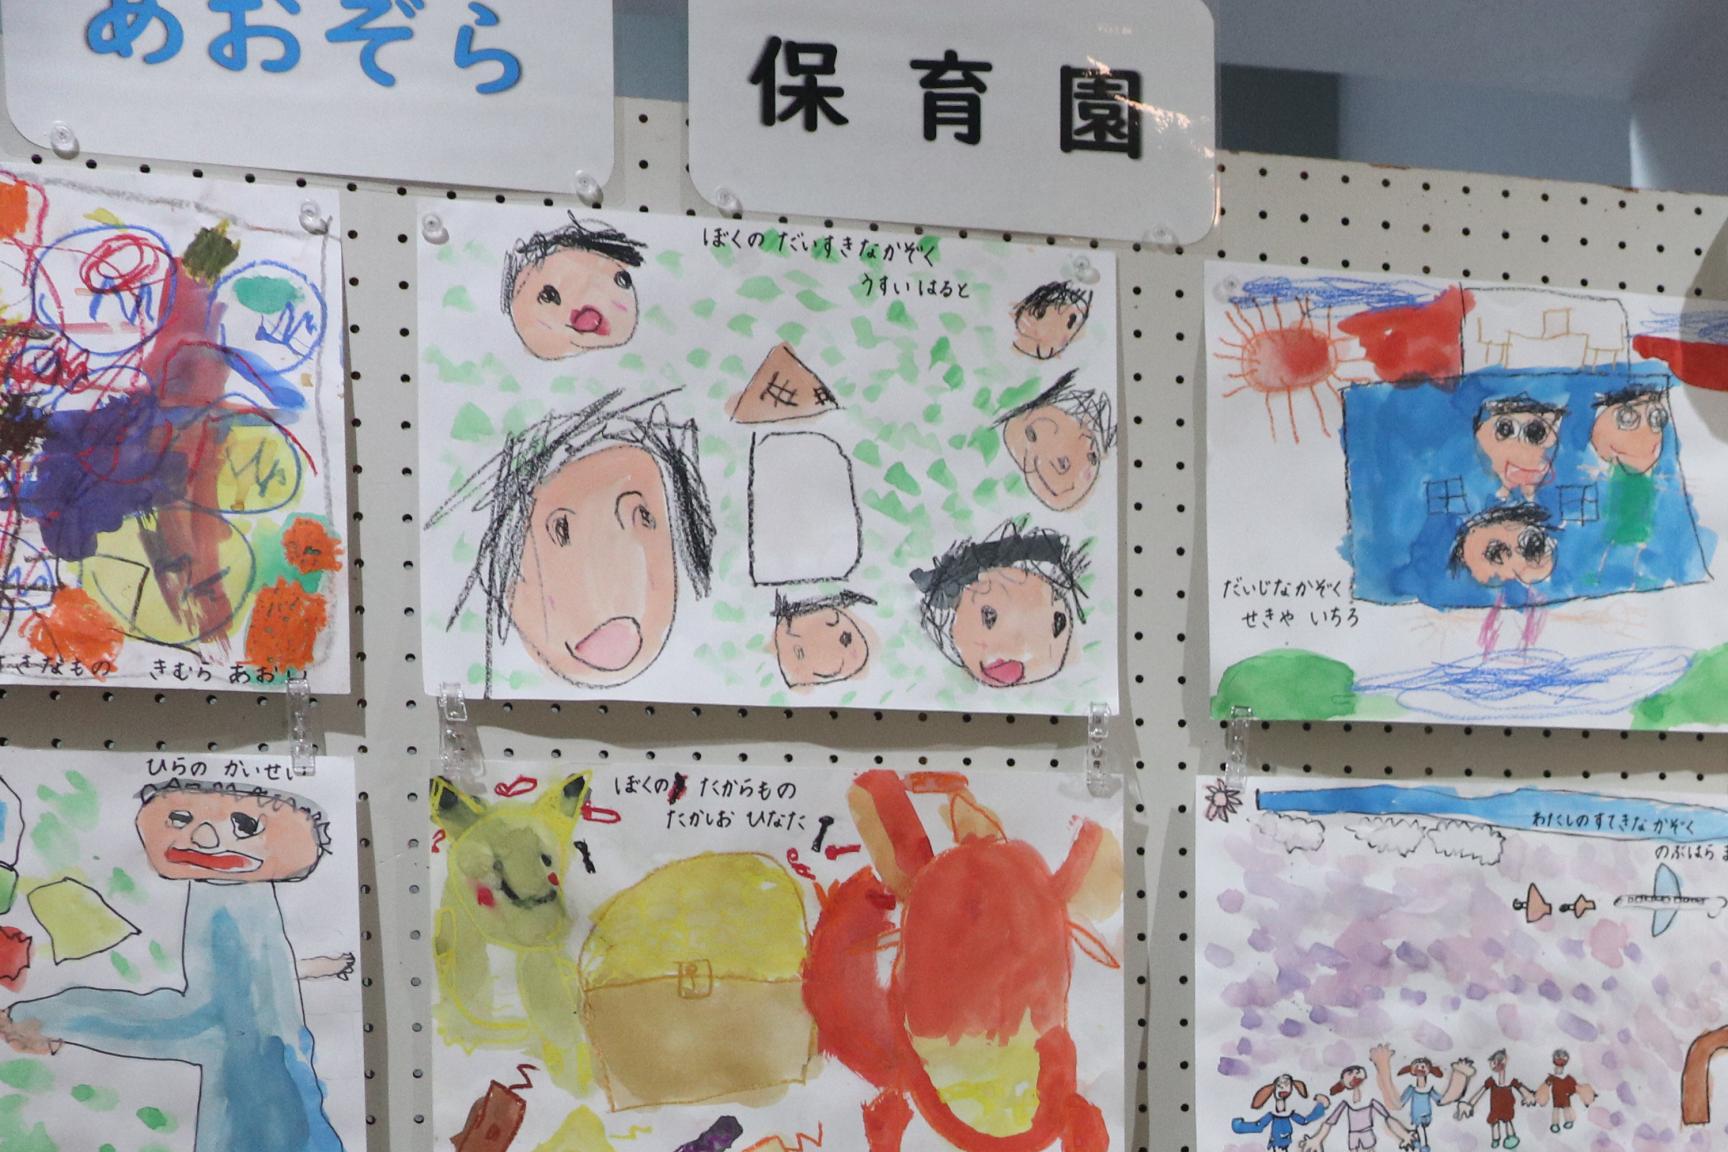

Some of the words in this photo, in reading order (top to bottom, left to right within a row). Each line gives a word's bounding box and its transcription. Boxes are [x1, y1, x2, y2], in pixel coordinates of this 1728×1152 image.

[748, 35, 1143, 160] 保育園
[703, 228, 764, 249] ぼくの
[778, 231, 935, 266] だいすきなかぞく
[1223, 576, 1341, 598] だいじなかぞく
[1242, 608, 1295, 628] せきや
[0, 655, 110, 677] きなもの
[150, 658, 212, 682] きむら
[146, 757, 207, 776] ひらの
[614, 775, 669, 795] ぼくの
[700, 777, 797, 800] たからもの
[666, 809, 735, 829] たかしお
[746, 810, 807, 831] ひなた
